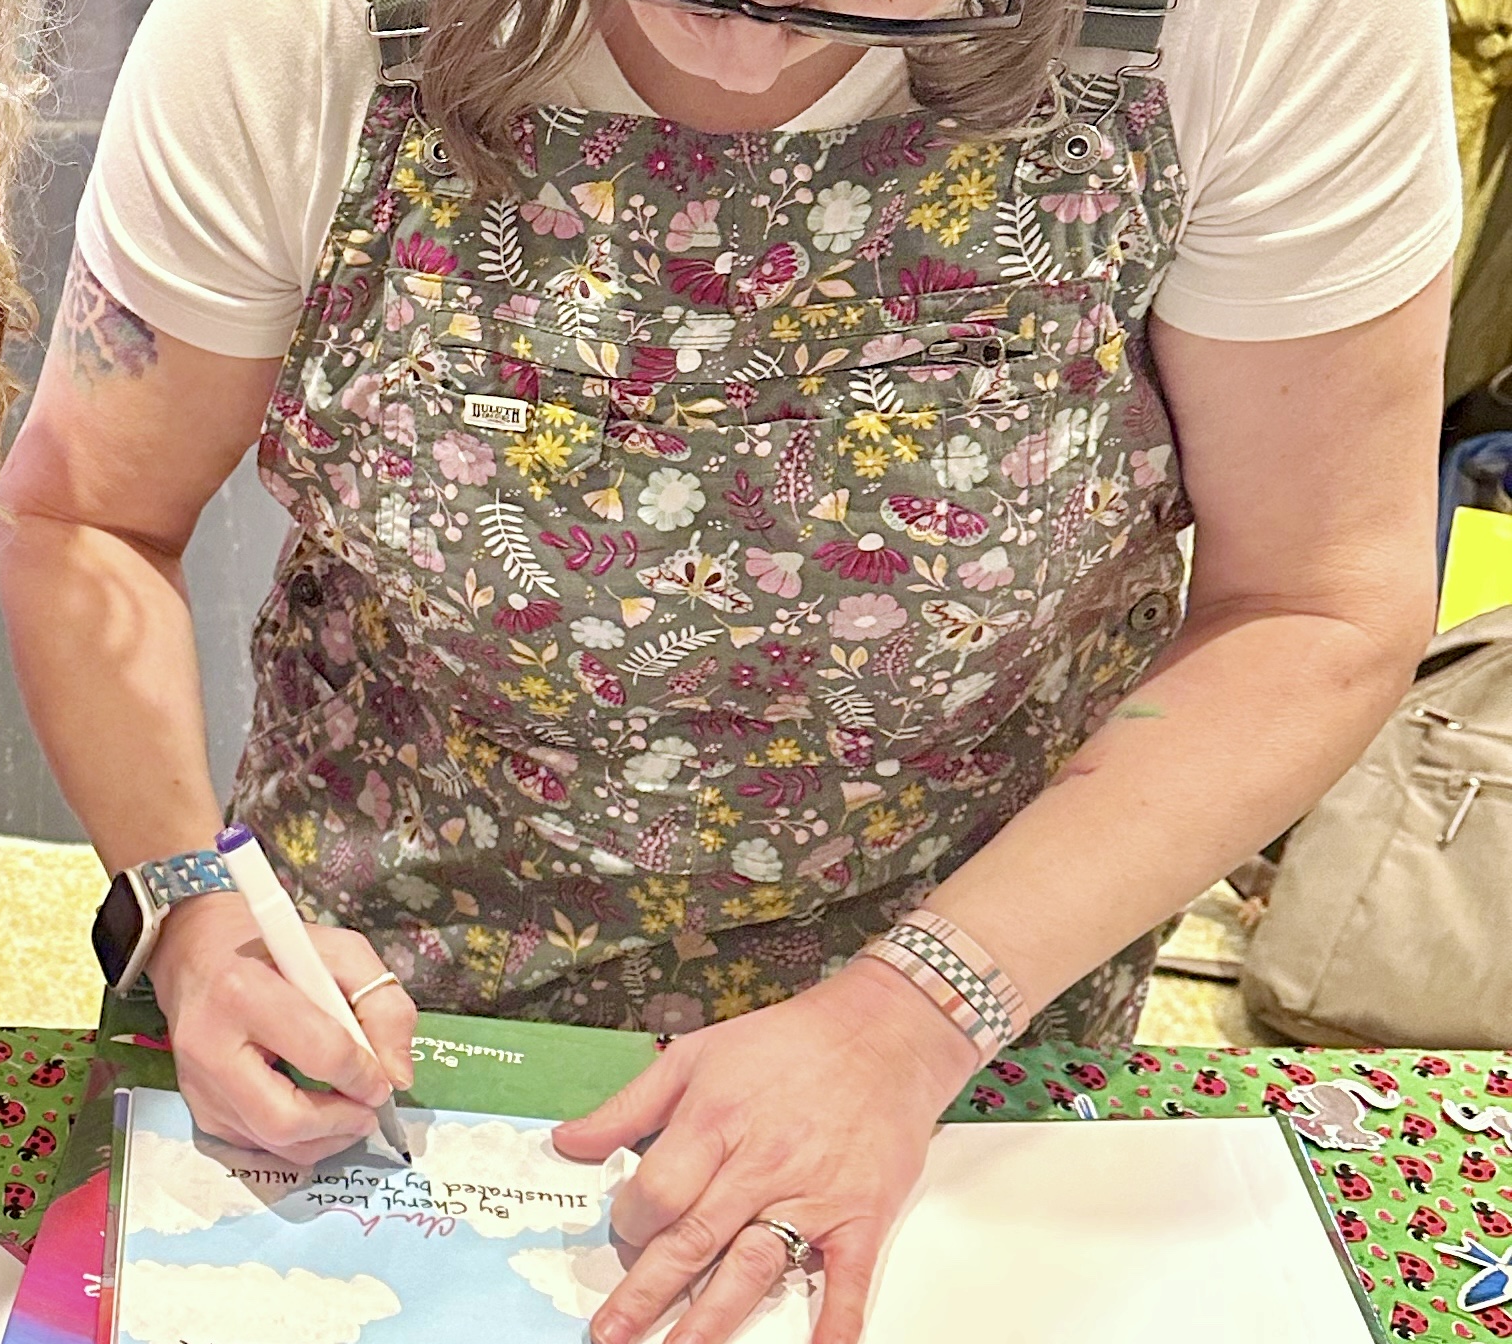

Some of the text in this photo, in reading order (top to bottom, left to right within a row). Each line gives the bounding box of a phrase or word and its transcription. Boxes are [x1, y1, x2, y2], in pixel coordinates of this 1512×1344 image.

[226, 1168, 588, 1209] Illustrated by Taylor Miller
[306, 1191, 510, 1219] By Cheryl Lock
